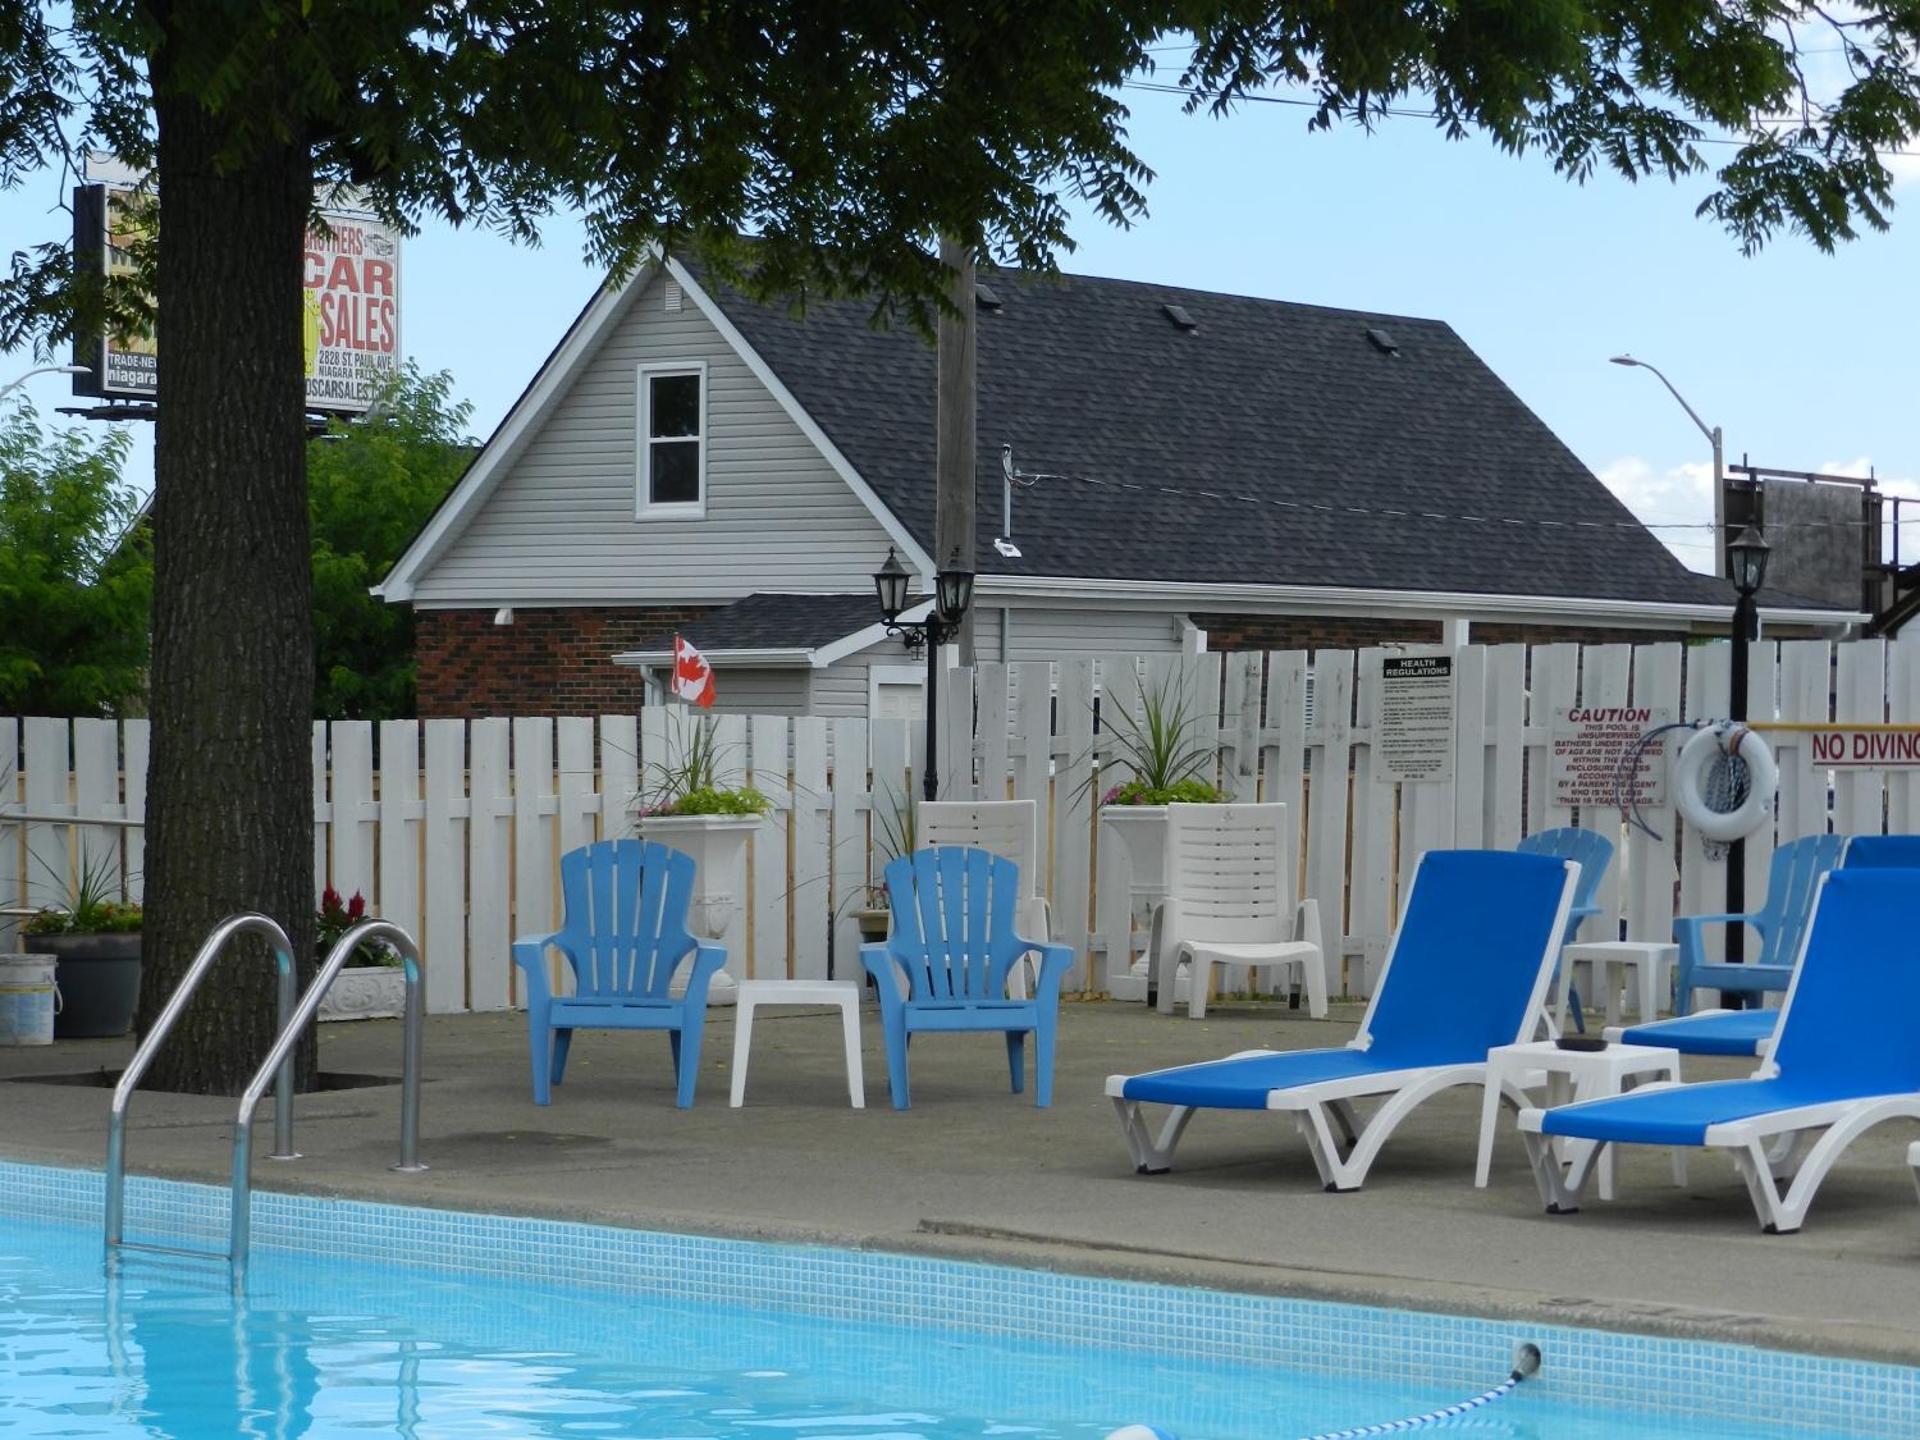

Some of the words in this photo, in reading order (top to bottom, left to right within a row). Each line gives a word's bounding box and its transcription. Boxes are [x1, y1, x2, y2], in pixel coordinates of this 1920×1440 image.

[304, 252, 393, 296] CAR
[320, 292, 394, 353] SALES
[108, 353, 157, 368] TRADE-NE
[320, 350, 340, 365] 2828
[320, 365, 353, 379] NIAGARA
[1400, 659, 1436, 667] HEALTH
[1385, 667, 1448, 676] REGULATIONS
[1568, 709, 1651, 722] CAUTION
[1812, 733, 1845, 760] NO
